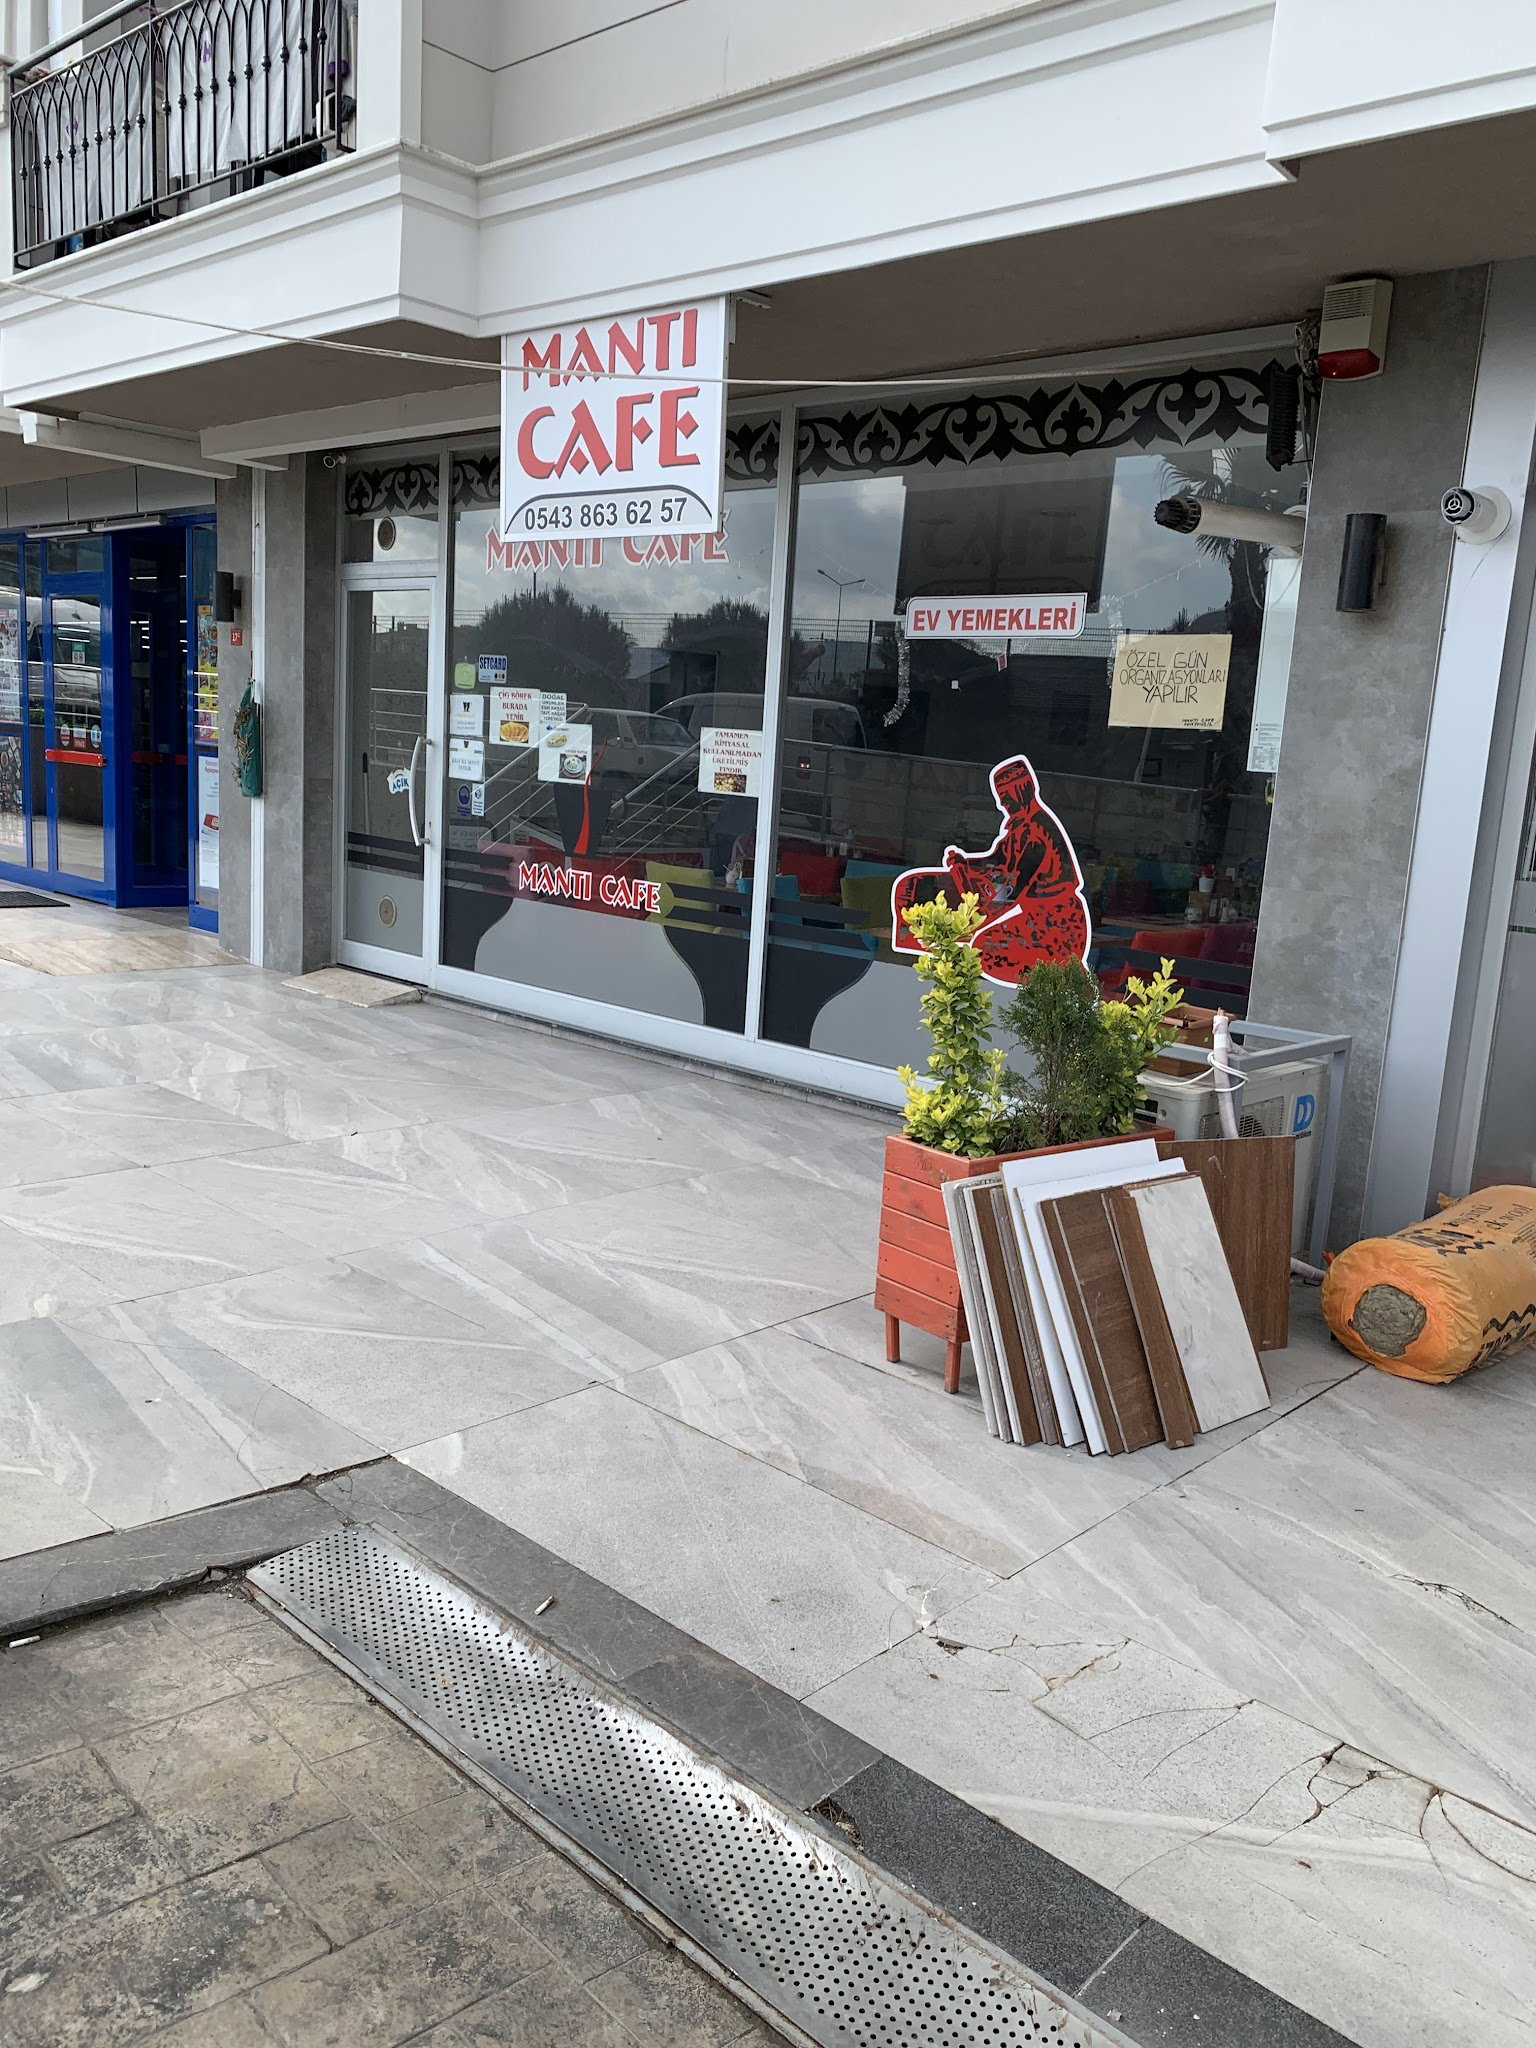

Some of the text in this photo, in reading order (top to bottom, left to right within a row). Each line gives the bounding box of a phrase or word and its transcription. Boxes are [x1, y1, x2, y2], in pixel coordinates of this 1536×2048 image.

[521, 308, 699, 393] MANTI
[516, 386, 701, 480] CAFE
[524, 497, 688, 531] 0543 863 62 57
[912, 601, 1077, 631] EV YEMEKLERİ
[480, 656, 507, 671] SETCARD
[1126, 649, 1209, 669] ÖZEL GÜN
[1142, 685, 1198, 704] YAPILIR
[502, 702, 528, 711] BURADA
[506, 712, 524, 720] YENİR
[714, 739, 750, 748] KİMYASAL
[715, 731, 749, 739] TAMAMEN
[703, 747, 762, 758] KULLANILMADAN
[393, 778, 409, 791] AÇIK
[518, 860, 662, 914] MANTI CAFE
